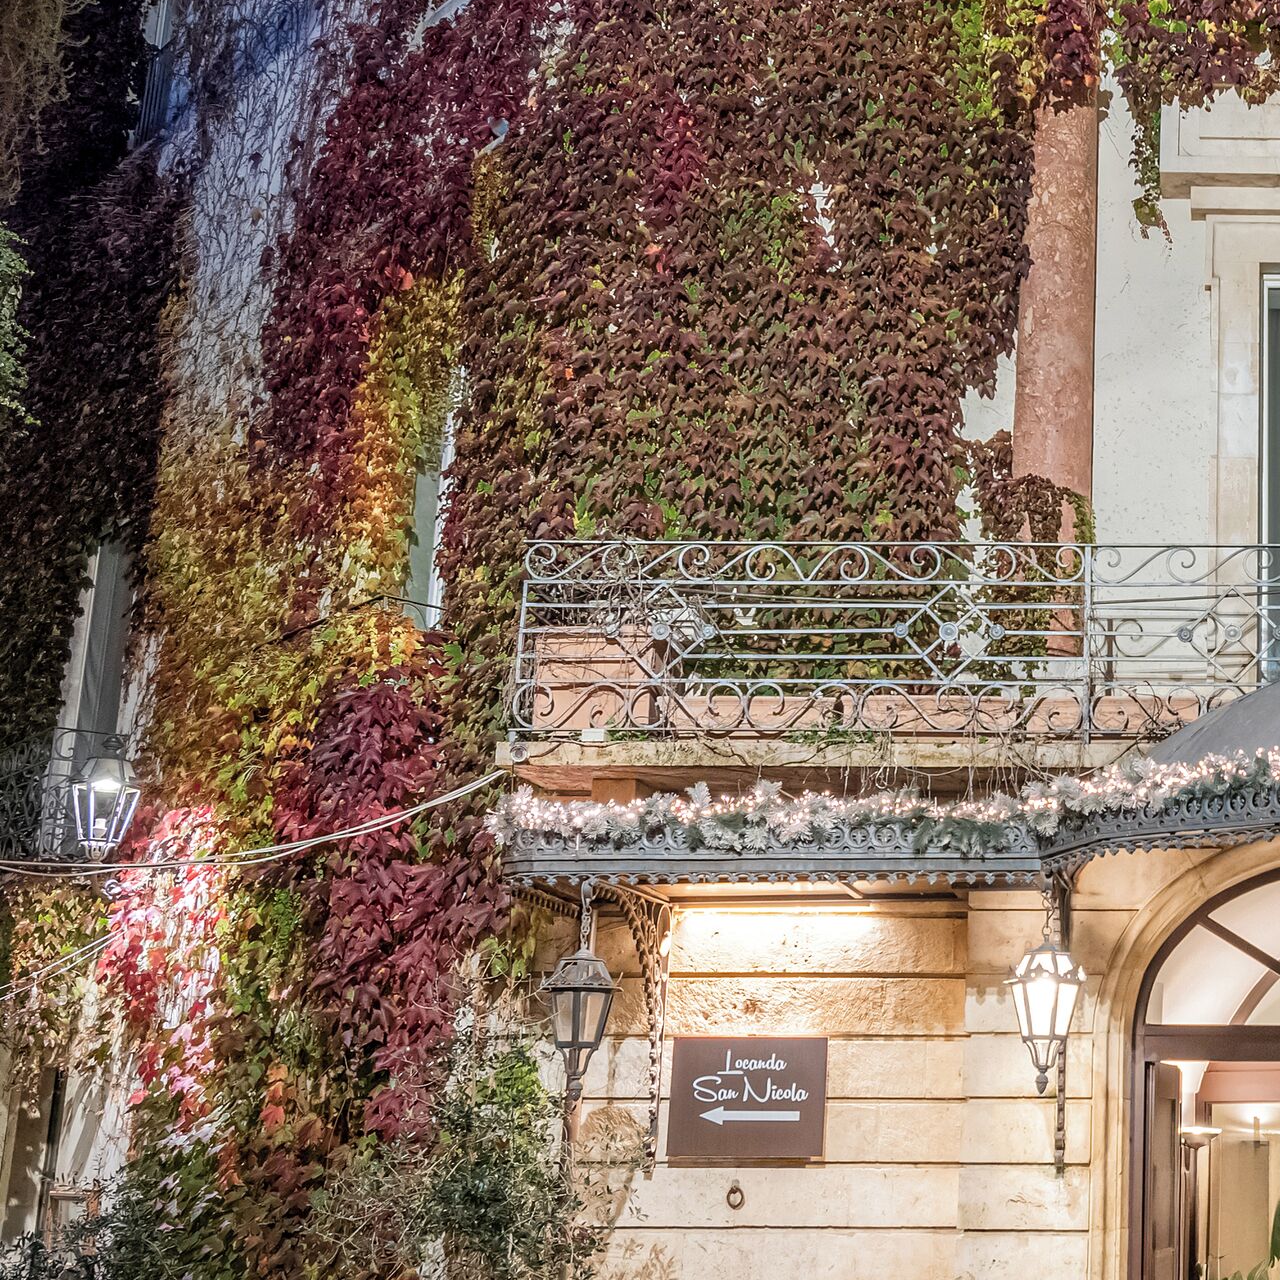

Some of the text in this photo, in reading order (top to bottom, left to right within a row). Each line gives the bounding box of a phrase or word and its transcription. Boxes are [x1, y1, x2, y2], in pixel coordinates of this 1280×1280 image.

[717, 1049, 787, 1075] Locanda
[692, 1075, 809, 1103] San Nicola
